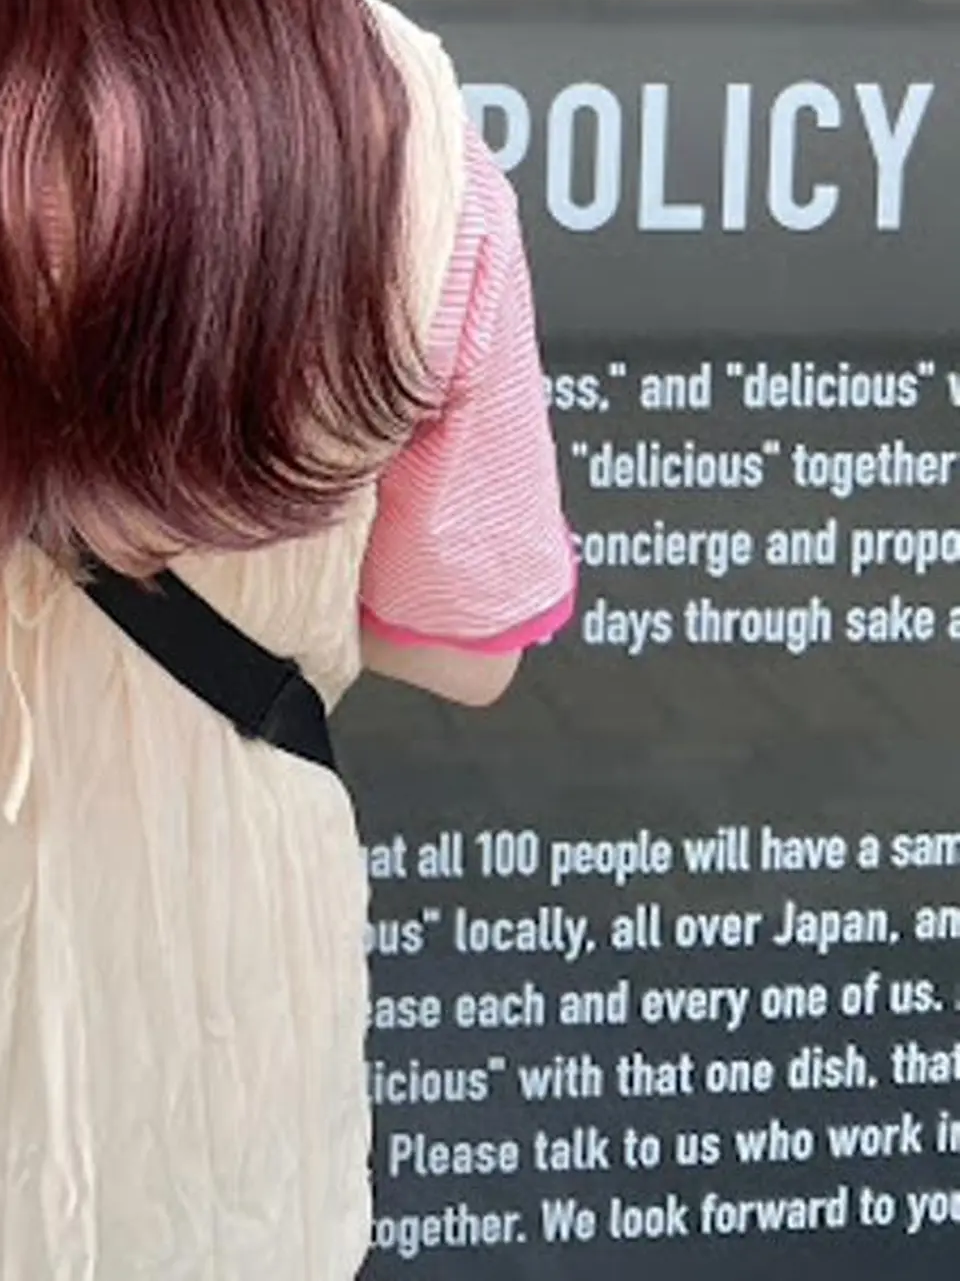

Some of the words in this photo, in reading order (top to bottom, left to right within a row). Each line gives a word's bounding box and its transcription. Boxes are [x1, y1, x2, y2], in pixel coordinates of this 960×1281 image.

[462, 82, 936, 232] POLICY
[639, 362, 712, 410] and
[726, 360, 935, 409] "delicious"
[571, 439, 781, 488] "delicious"
[791, 439, 960, 499] together
[765, 517, 838, 565] and
[851, 528, 960, 577] propo
[582, 597, 673, 655] days
[683, 595, 832, 655] through
[845, 594, 936, 642] sake
[417, 831, 463, 878] all
[475, 829, 539, 877] 100
[551, 828, 672, 887] people
[682, 825, 751, 873] will
[760, 825, 848, 871] have
[856, 834, 881, 869] a
[455, 906, 596, 961] locally,
[611, 903, 661, 950] all
[675, 912, 763, 947] over
[772, 899, 899, 955] Japan,
[455, 982, 545, 1028] each
[559, 979, 629, 1025] and
[641, 987, 750, 1032] every
[761, 983, 828, 1019] one
[841, 971, 881, 1016] of
[890, 979, 943, 1014] us.
[518, 1053, 603, 1100] with
[616, 1052, 694, 1096] that
[706, 1059, 774, 1093] one
[787, 1044, 878, 1089] dish,
[390, 1133, 519, 1177] Please
[534, 1126, 609, 1171] talk
[623, 1128, 660, 1168] to
[676, 1133, 721, 1165] us
[735, 1119, 814, 1162] who
[827, 1112, 922, 1158] work
[541, 1198, 596, 1242] We
[610, 1194, 688, 1239] look
[701, 1185, 848, 1234] forward
[859, 1187, 895, 1225] to
